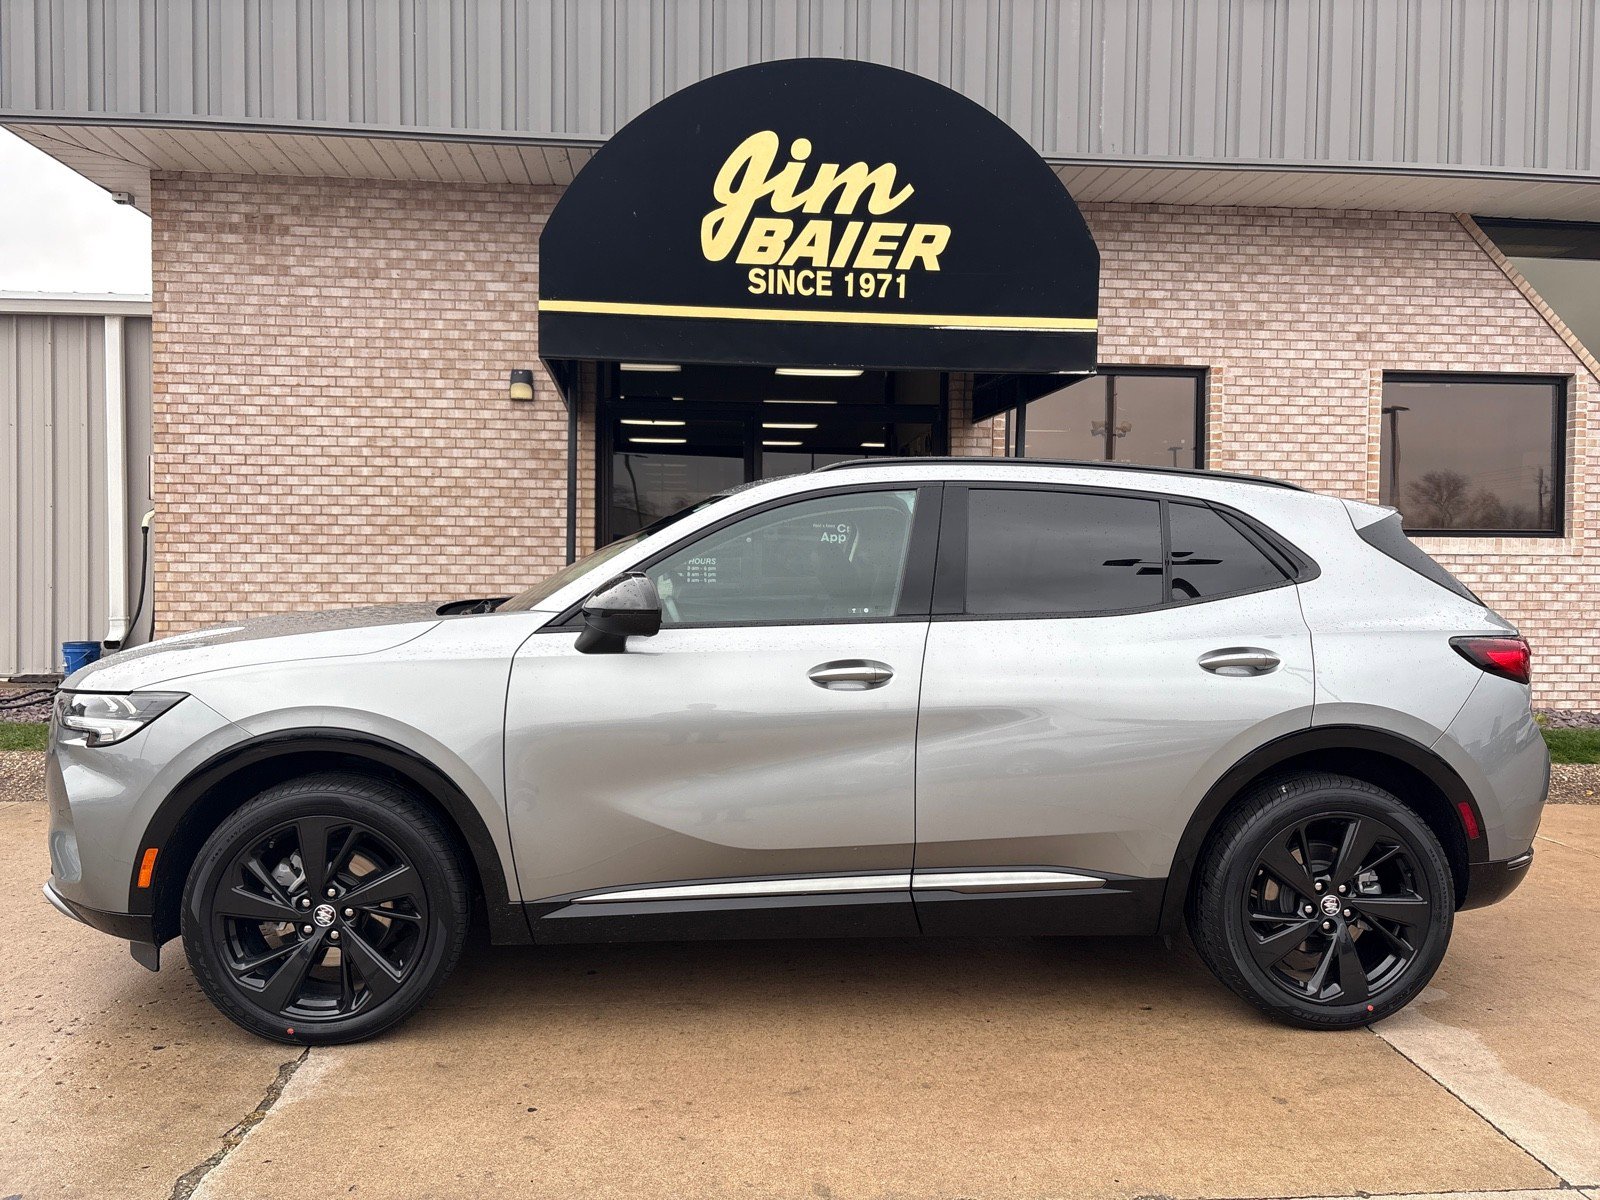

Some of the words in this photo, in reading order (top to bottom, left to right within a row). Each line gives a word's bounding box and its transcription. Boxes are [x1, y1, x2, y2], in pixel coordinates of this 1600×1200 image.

[700, 130, 915, 262] Jim
[735, 217, 951, 271] BAIER
[748, 268, 833, 297] SINCE
[844, 272, 906, 299] 1971
[821, 532, 846, 544] App
